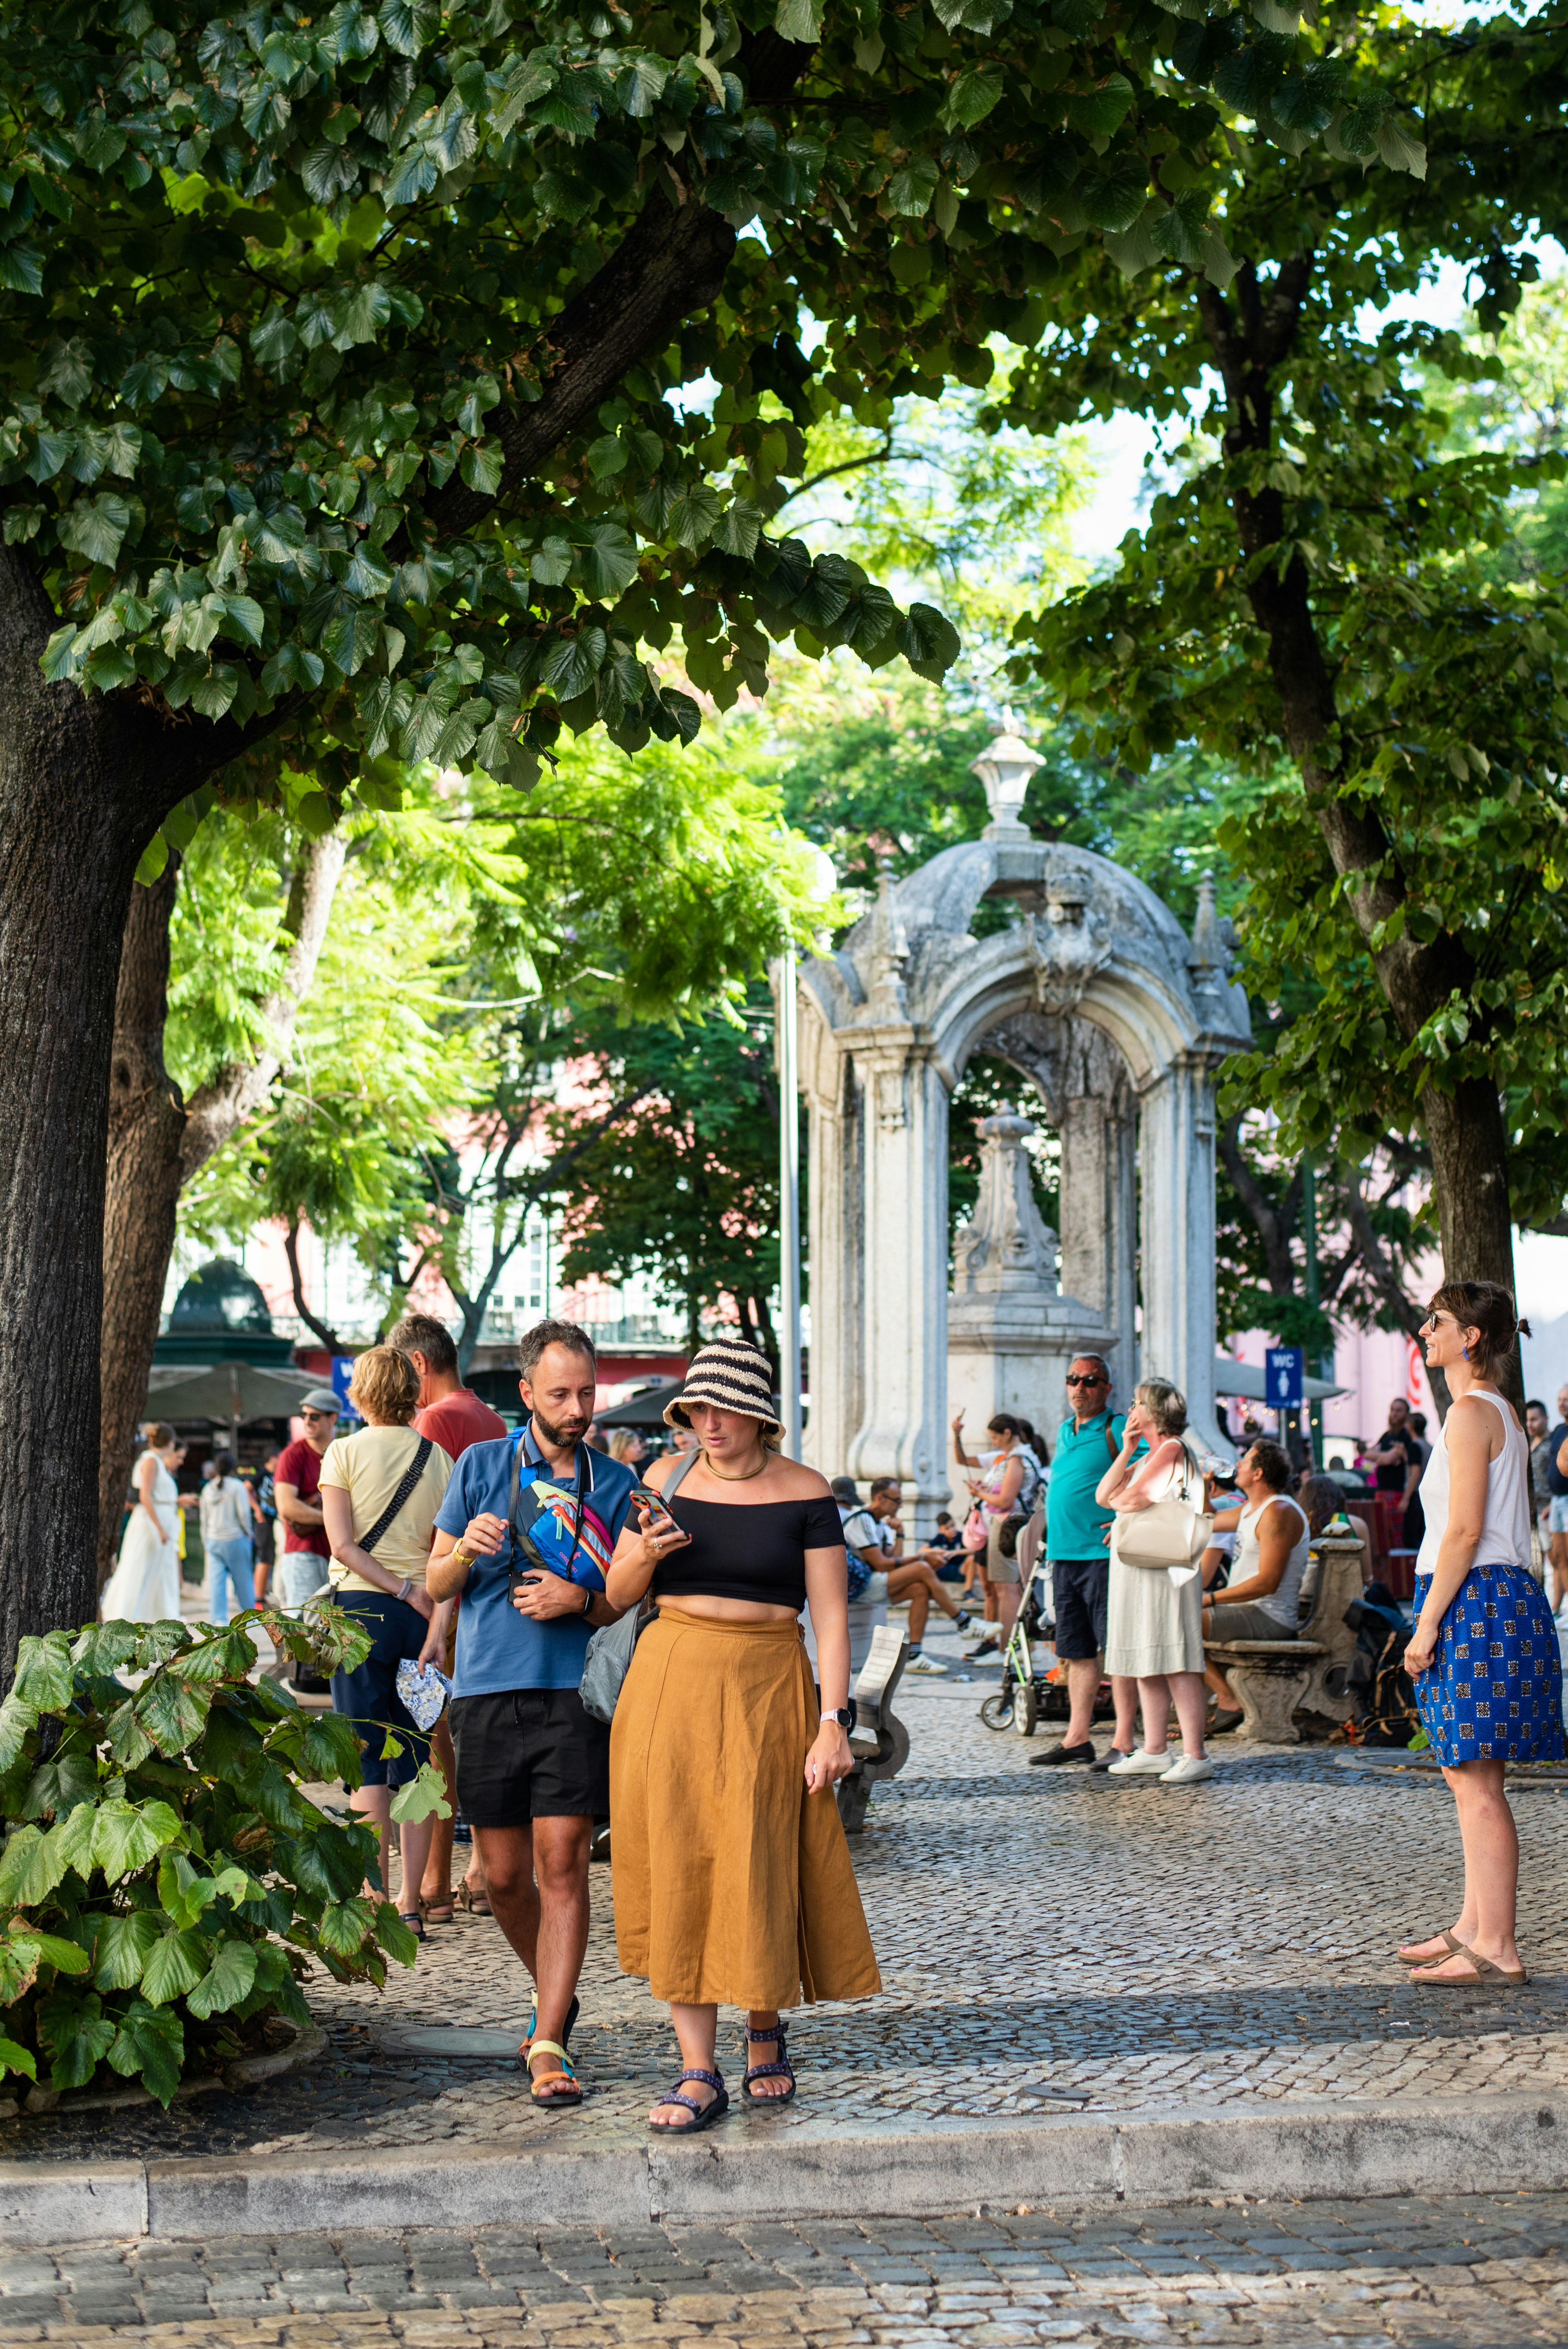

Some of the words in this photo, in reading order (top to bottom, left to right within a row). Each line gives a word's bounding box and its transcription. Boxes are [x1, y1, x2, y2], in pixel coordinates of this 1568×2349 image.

[340, 1361, 354, 1378] W
[1272, 1354, 1294, 1368] WC
[559, 1551, 578, 1573] cotoxi
